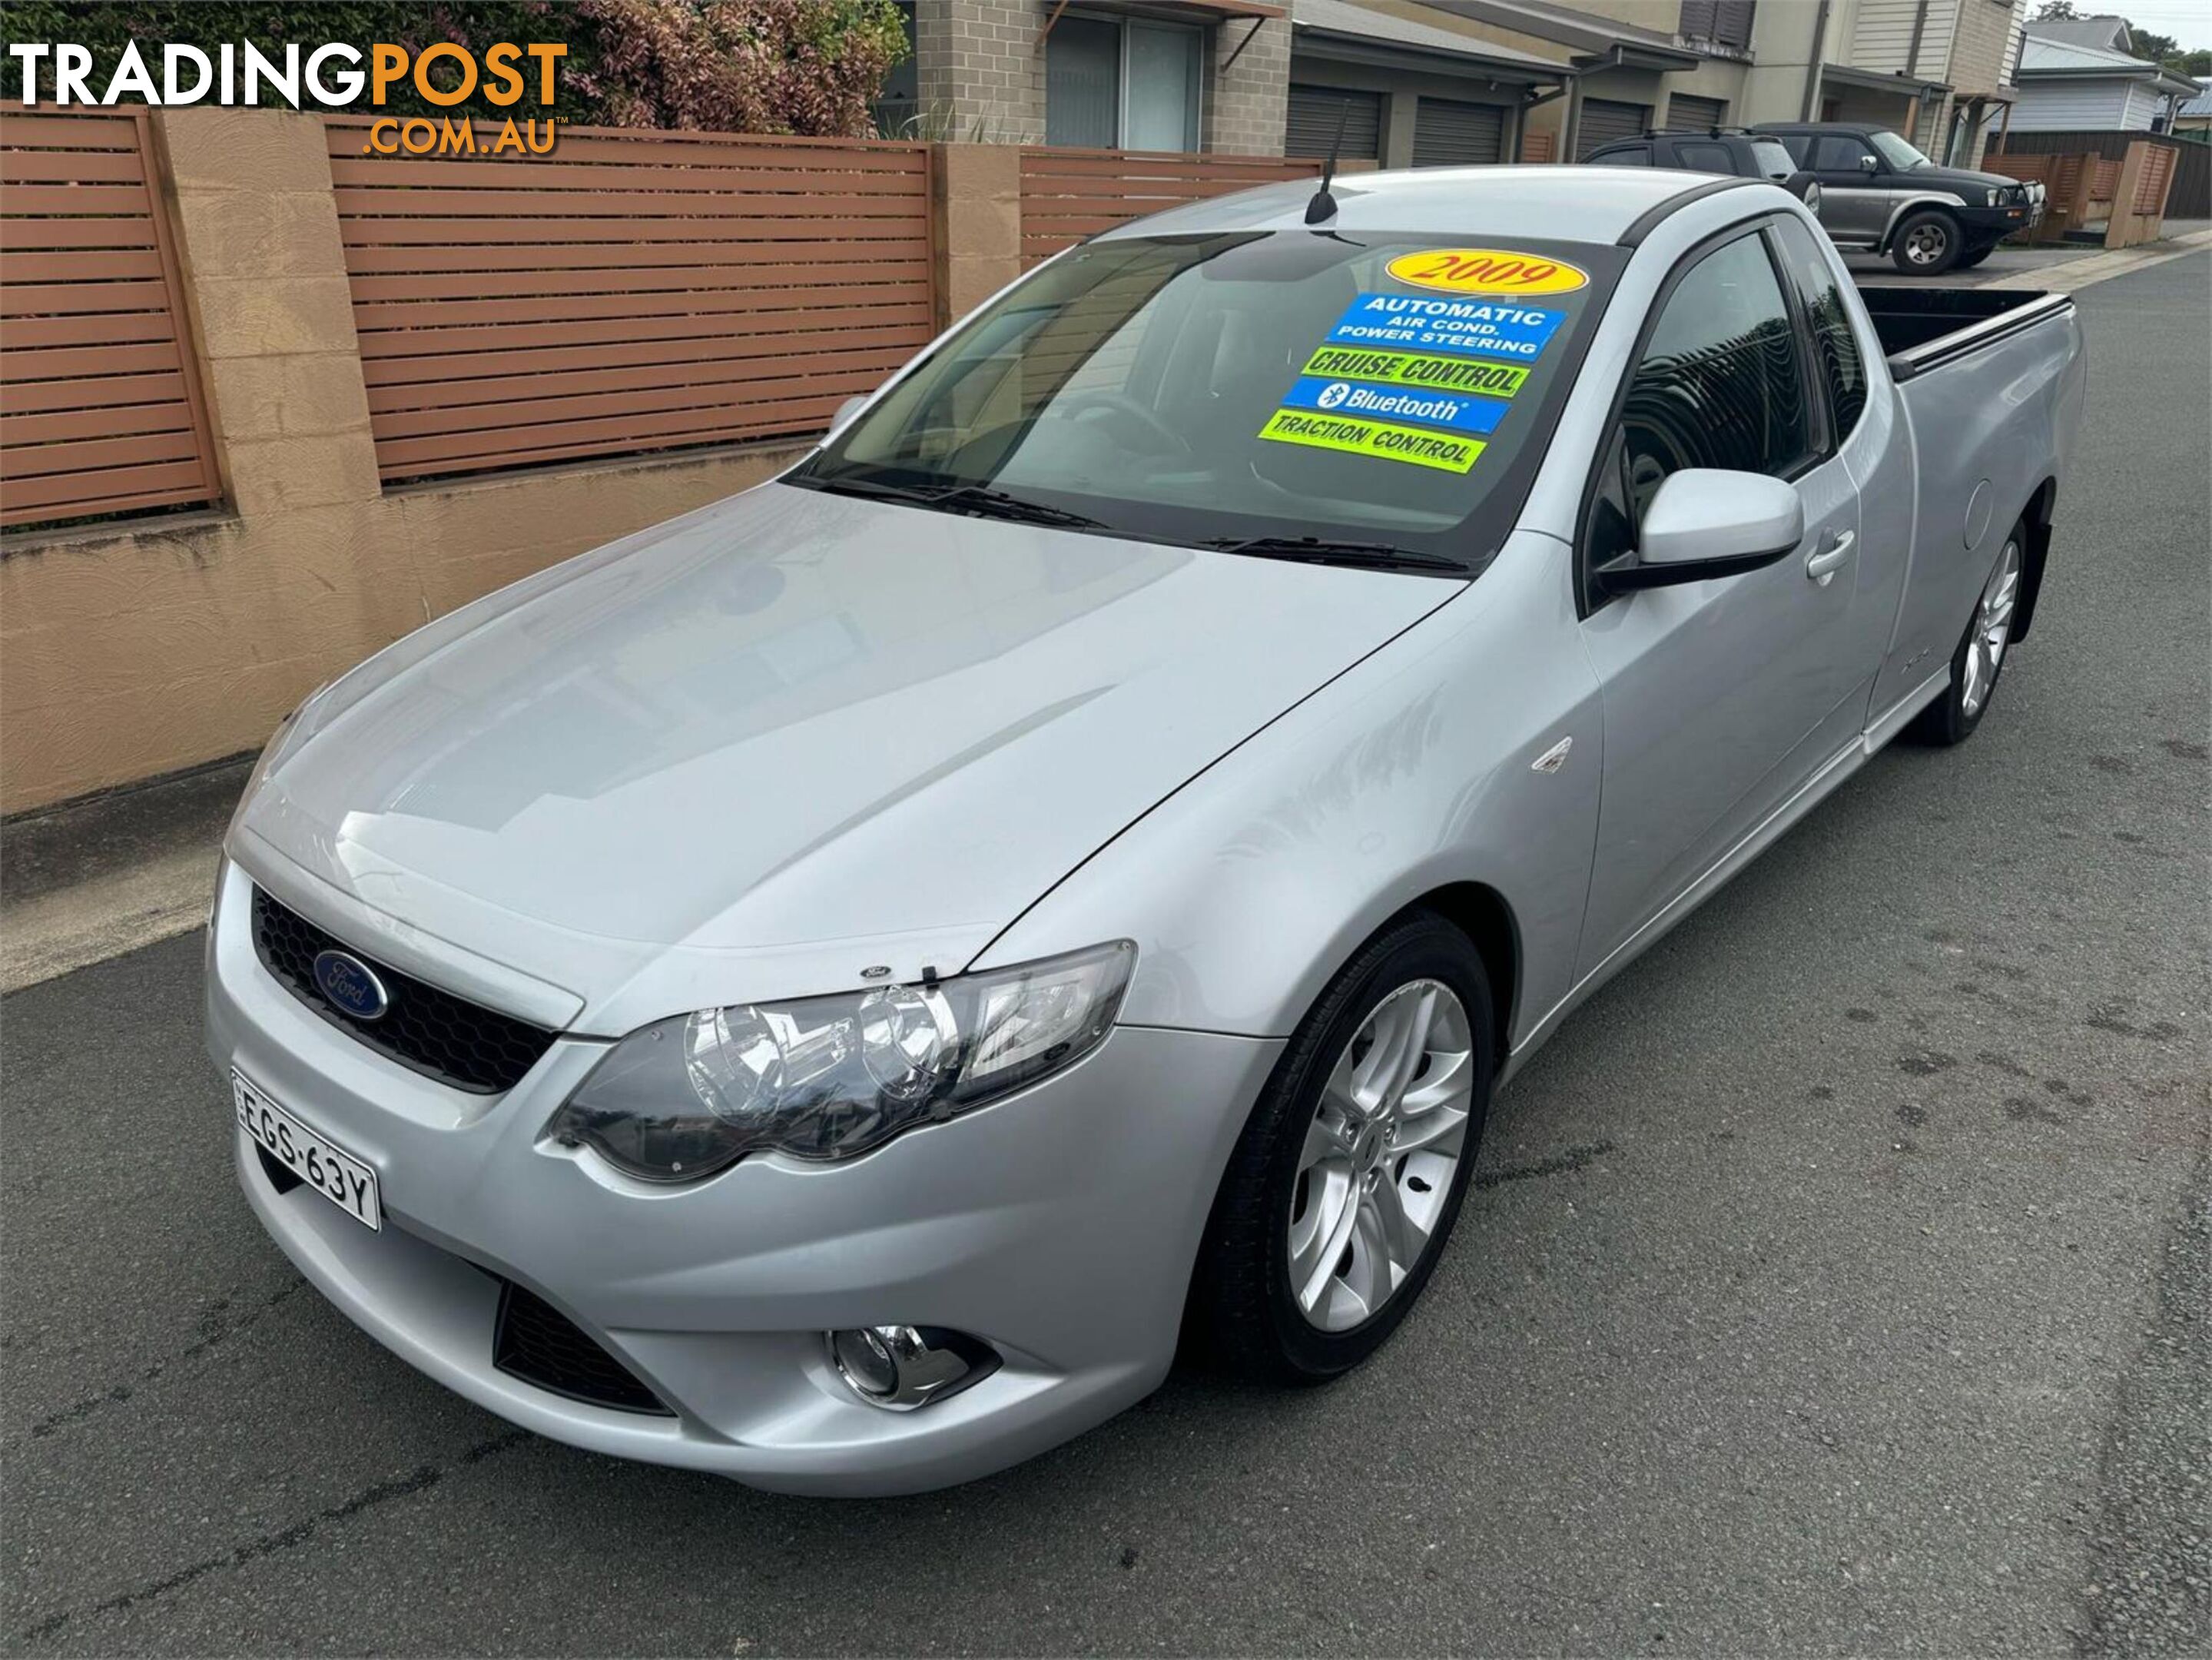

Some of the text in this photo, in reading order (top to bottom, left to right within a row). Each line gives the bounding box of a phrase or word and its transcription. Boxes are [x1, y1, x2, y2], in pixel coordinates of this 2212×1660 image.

[1411, 255, 1557, 285] 2009
[1365, 297, 1546, 326] AUTOMATIC
[1387, 316, 1500, 336] AIR COND.
[1338, 326, 1537, 354] POWER STEERING
[1308, 350, 1521, 392] CRUISE CONTROL
[1272, 416, 1471, 463] TRACTION CONTROL
[327, 961, 369, 1006] Ford
